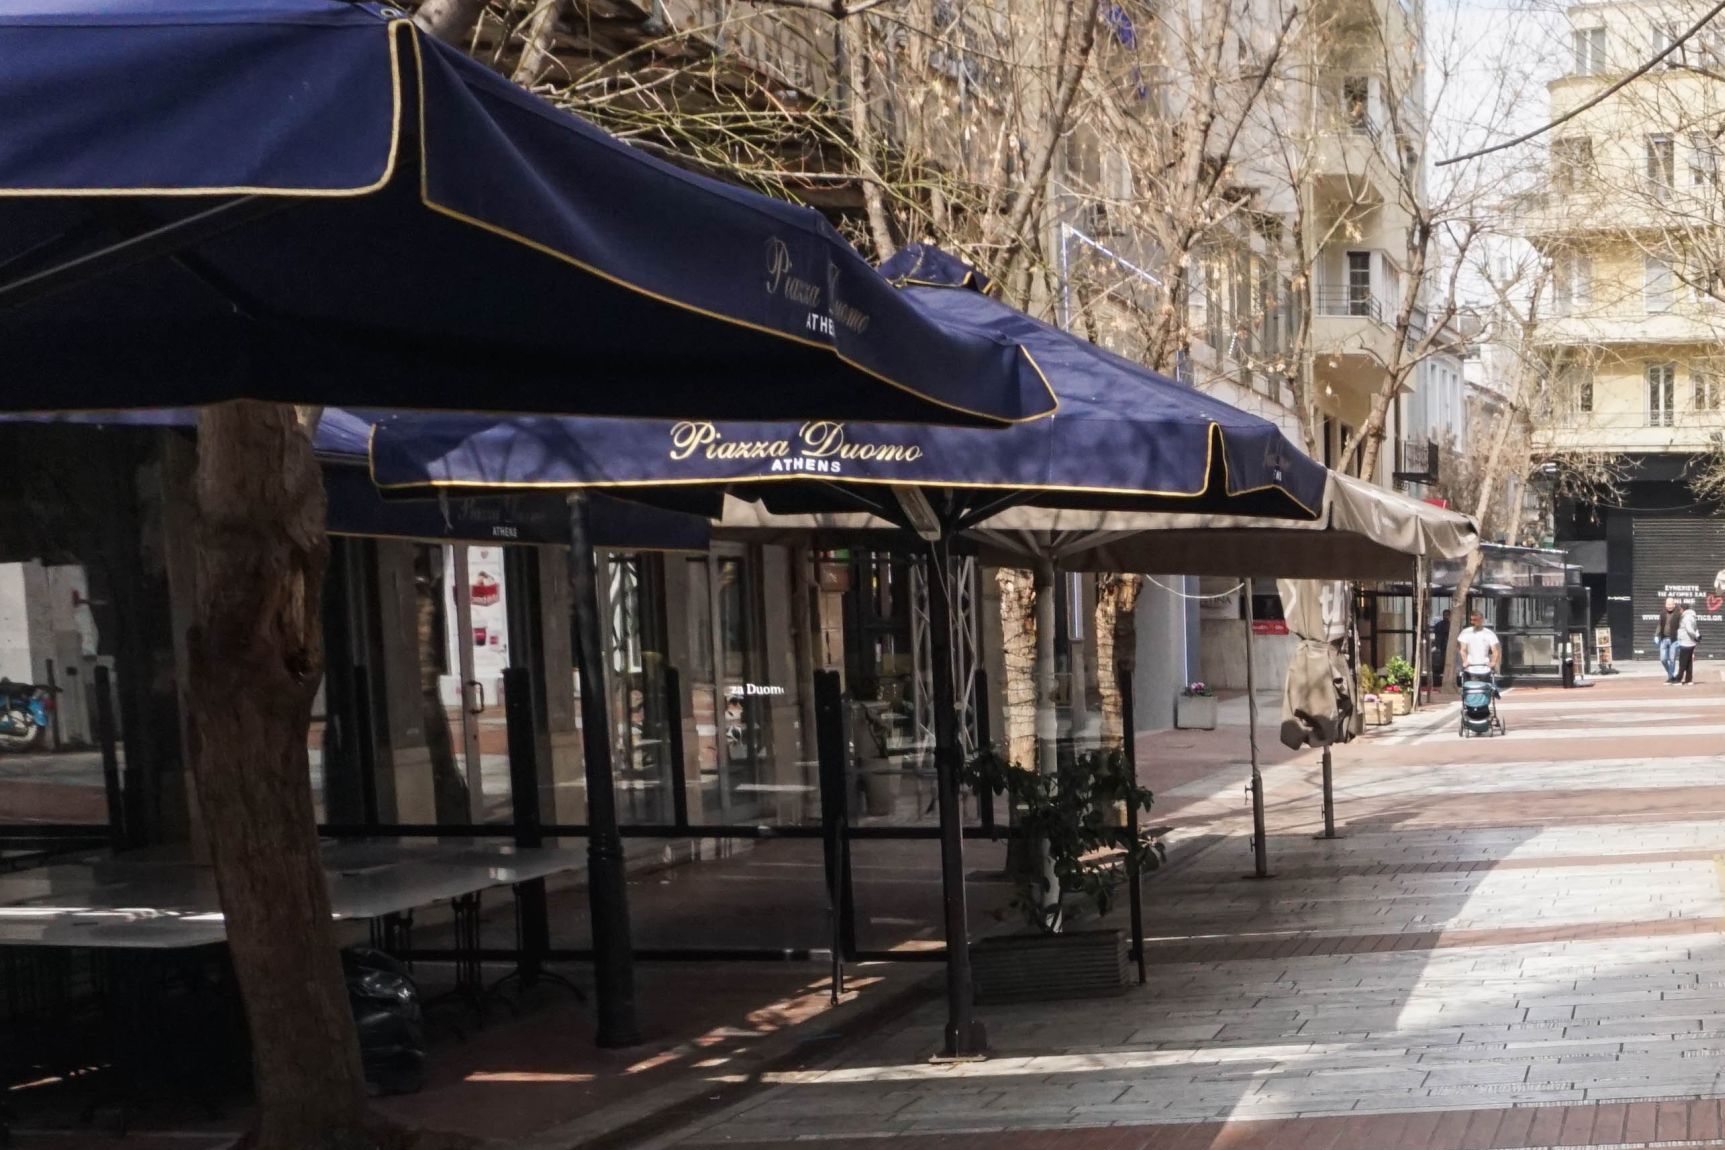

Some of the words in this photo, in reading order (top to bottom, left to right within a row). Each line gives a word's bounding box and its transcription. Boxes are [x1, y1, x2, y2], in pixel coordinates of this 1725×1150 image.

[806, 312, 836, 337] ATHE
[670, 420, 790, 461] Piazza
[799, 420, 923, 462] Duomo
[771, 458, 841, 473] ATHENS
[492, 526, 518, 538] ATHENS
